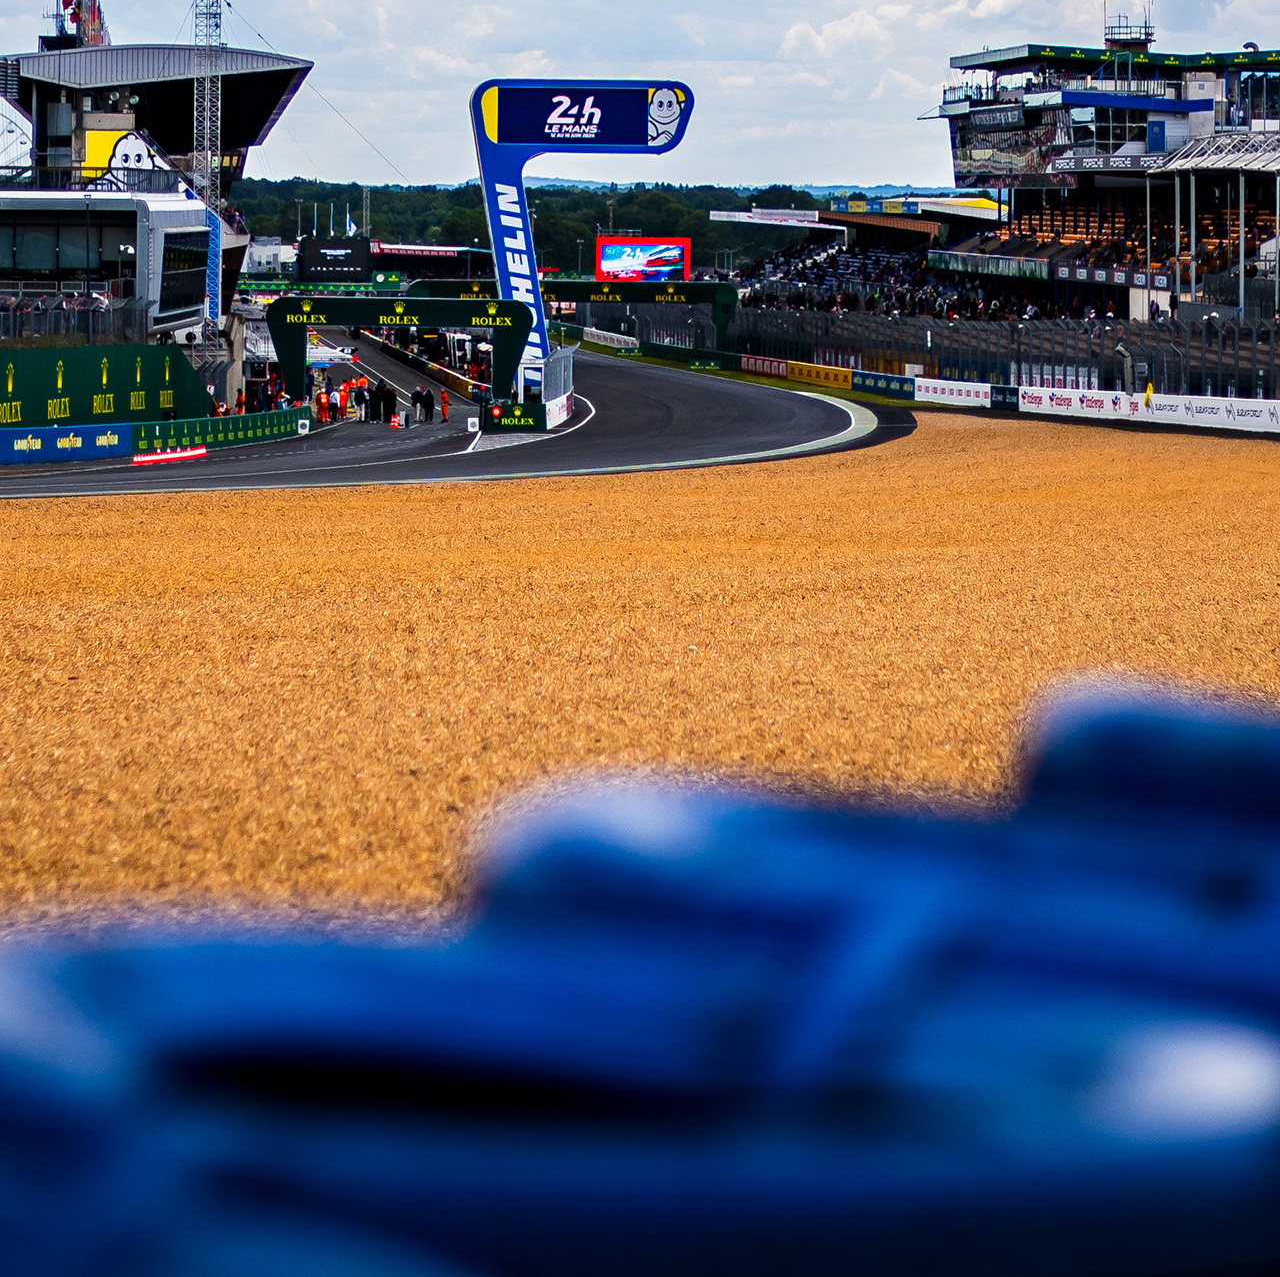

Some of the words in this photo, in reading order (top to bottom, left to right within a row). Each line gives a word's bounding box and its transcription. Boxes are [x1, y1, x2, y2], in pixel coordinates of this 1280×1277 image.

[547, 95, 601, 124] 24h
[545, 125, 560, 133] LE
[562, 125, 597, 133] MANS
[1055, 159, 1075, 169] PORSCHE
[1083, 158, 1104, 168] PORSCHE
[1110, 157, 1131, 168] PORSCHE
[495, 183, 543, 381] MHELIN
[286, 314, 327, 324] ROLEX
[379, 315, 419, 325] ROLEX
[471, 316, 512, 326] ROLEX
[47, 398, 70, 419] ROLEX
[93, 394, 114, 414] ROLEX
[501, 417, 534, 426] ROLEX
